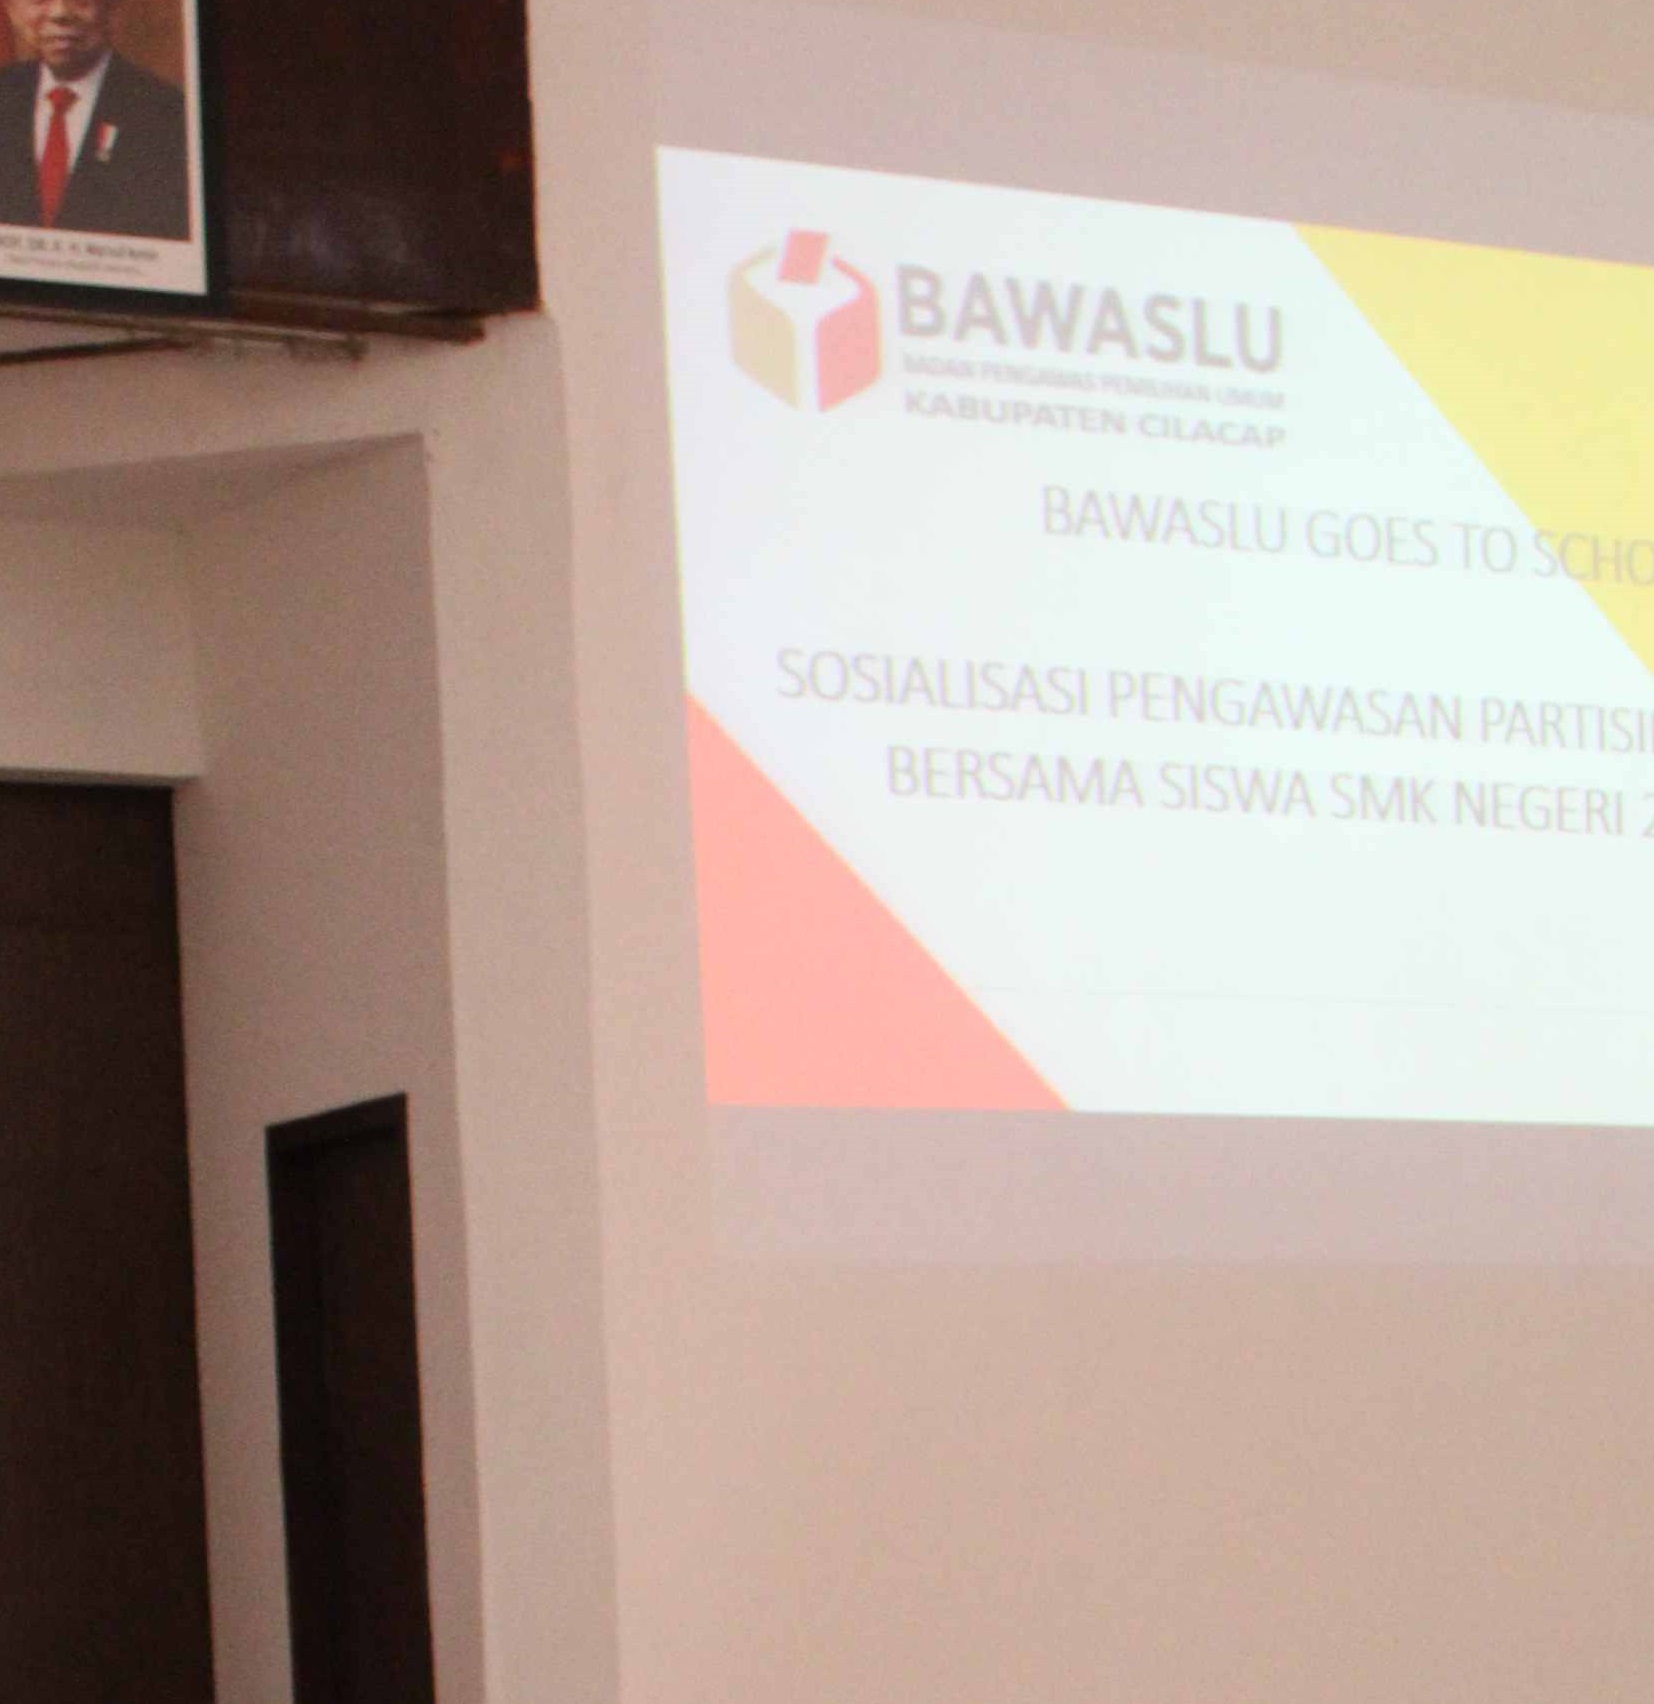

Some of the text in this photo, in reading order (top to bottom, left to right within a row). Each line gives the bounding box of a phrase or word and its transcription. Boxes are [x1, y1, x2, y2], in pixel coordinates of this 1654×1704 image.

[896, 263, 1283, 374] BAWASLU
[905, 387, 1288, 450] KABUPATEN CILACAP
[1041, 484, 1287, 555] BAWASLU
[1305, 509, 1440, 567] GOES
[1453, 520, 1519, 574] TO
[775, 646, 1088, 717] SOSIALISASI
[1108, 669, 1462, 741] PENGAWASAN
[886, 744, 1145, 809] BERSAMA
[1158, 761, 1316, 818] SISWA
[1330, 771, 1438, 826] SMK
[1454, 778, 1625, 837] NEGERI
